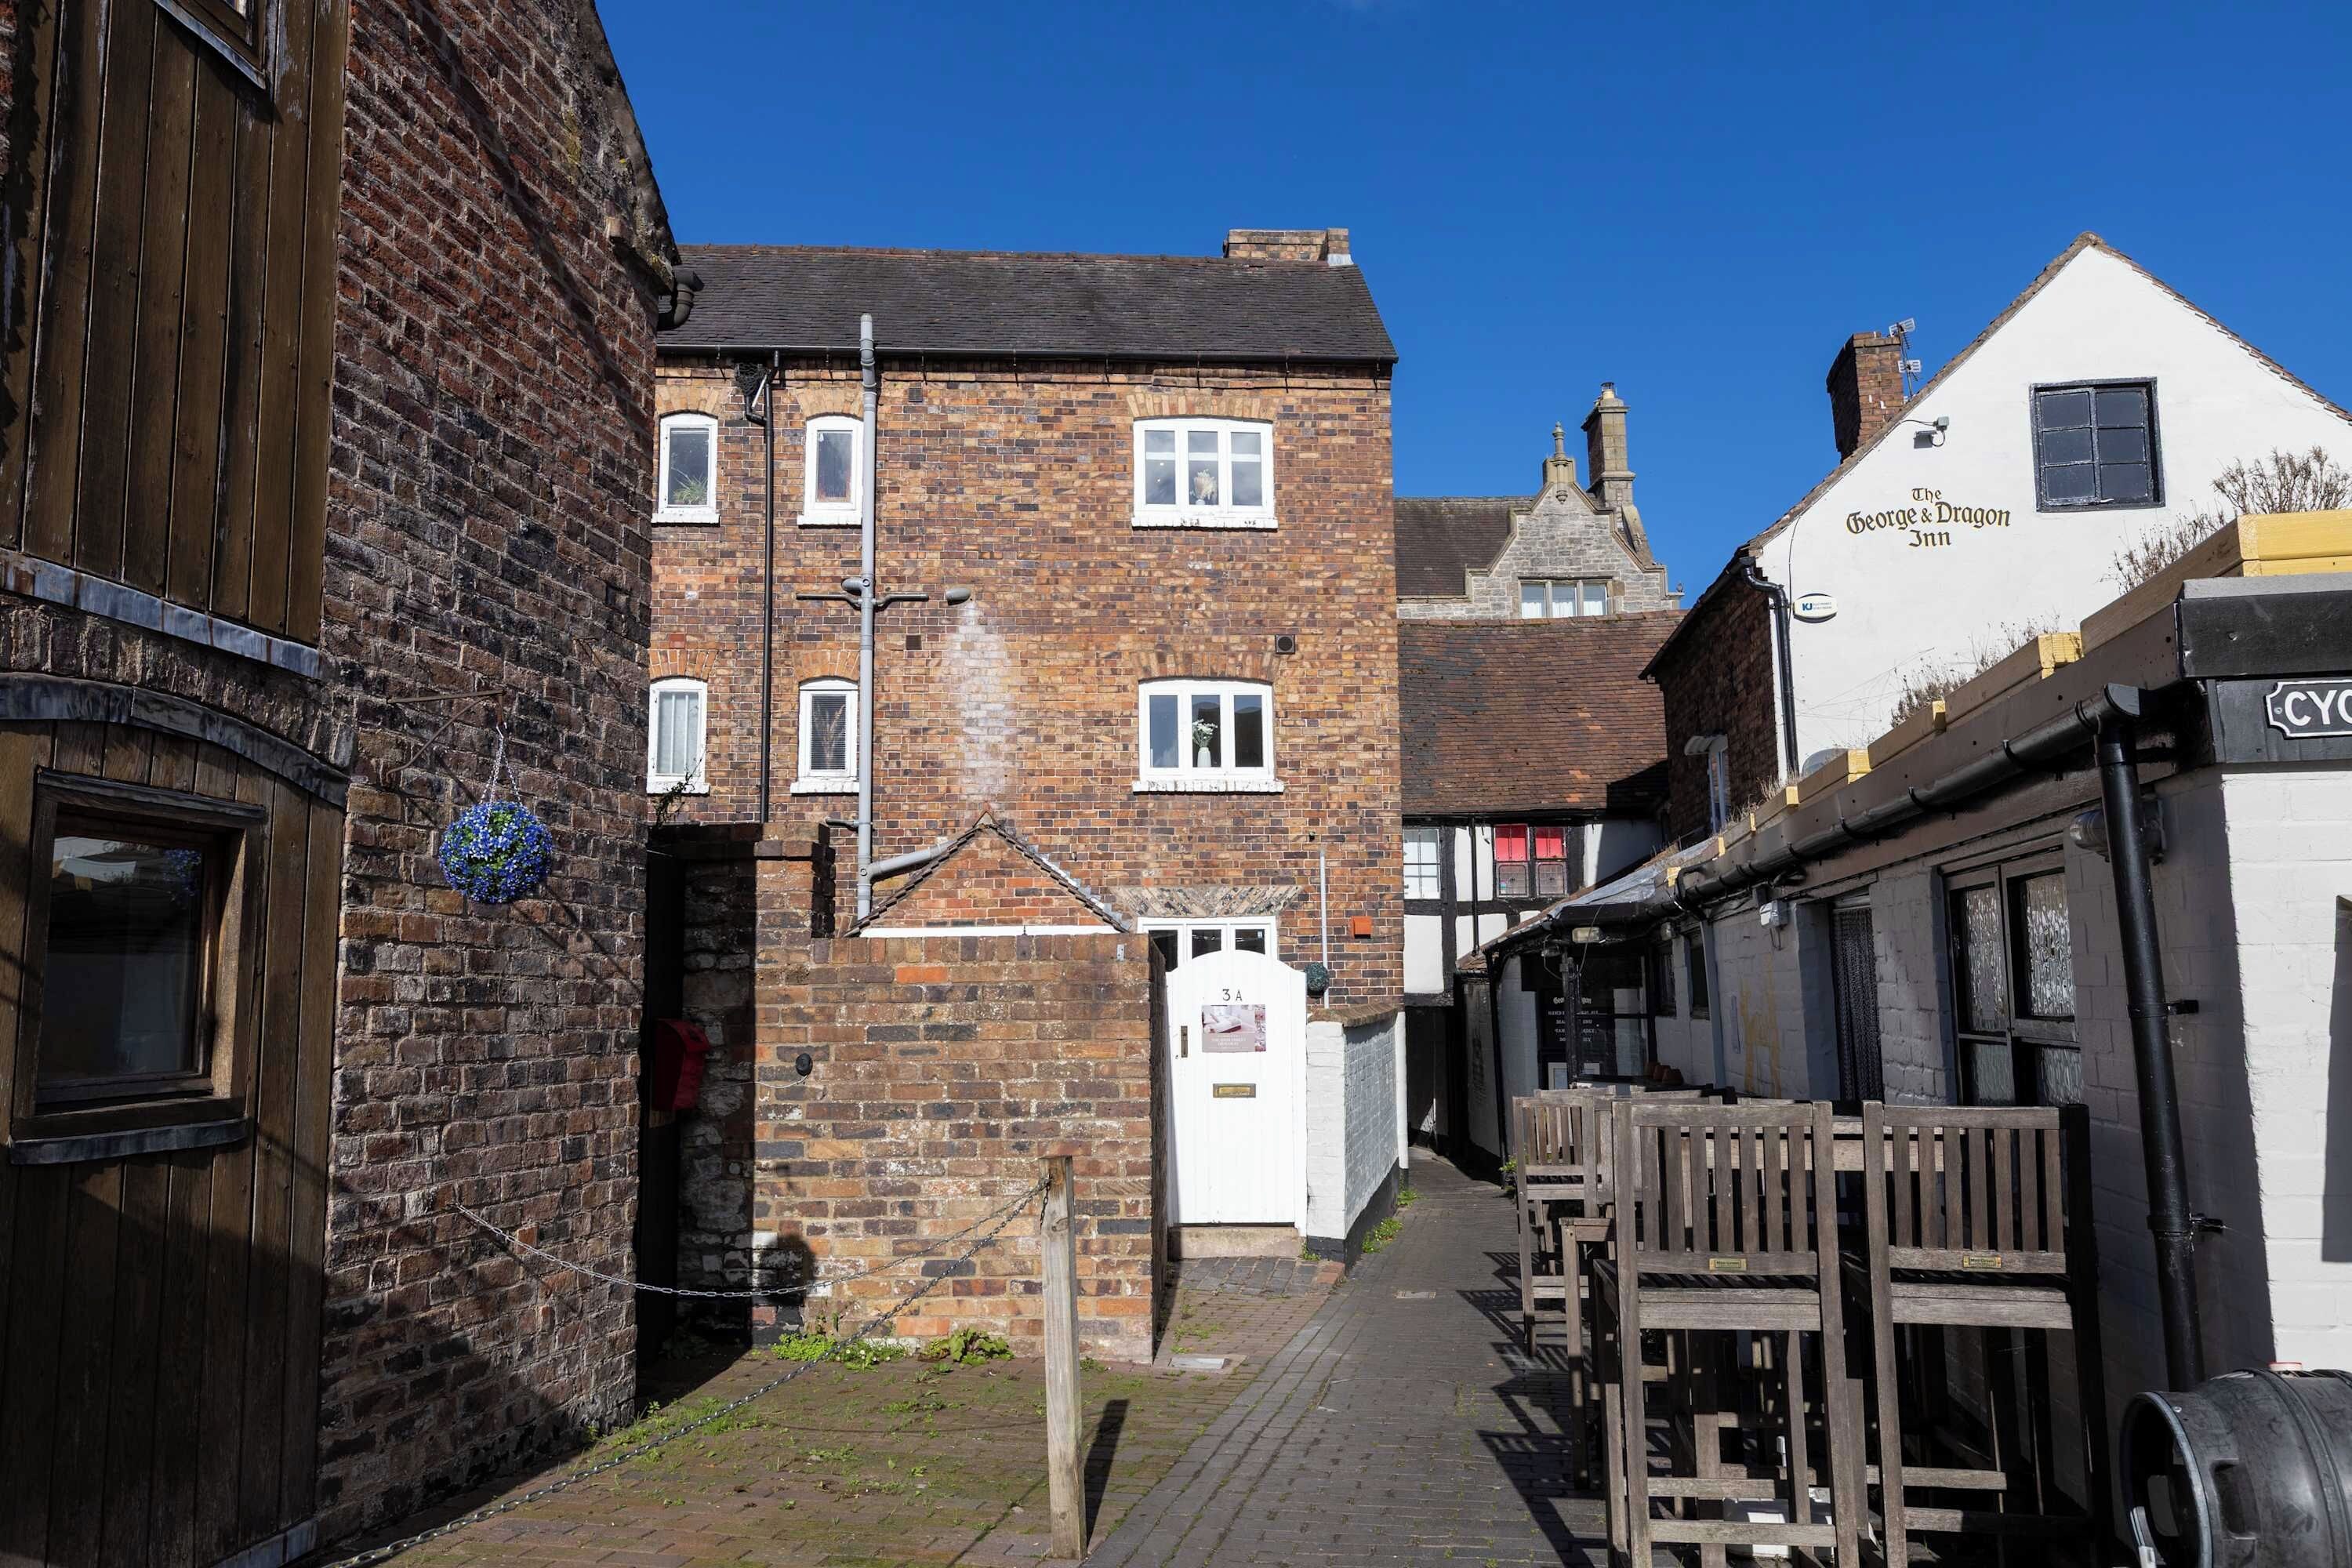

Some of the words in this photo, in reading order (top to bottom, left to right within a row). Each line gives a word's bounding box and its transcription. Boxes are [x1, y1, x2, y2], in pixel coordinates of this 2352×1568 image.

[1911, 488, 1942, 503] The
[1846, 507, 1918, 535] George
[1921, 507, 1933, 524] &
[1935, 501, 2011, 529] Dragon
[1908, 529, 1951, 547] Inn
